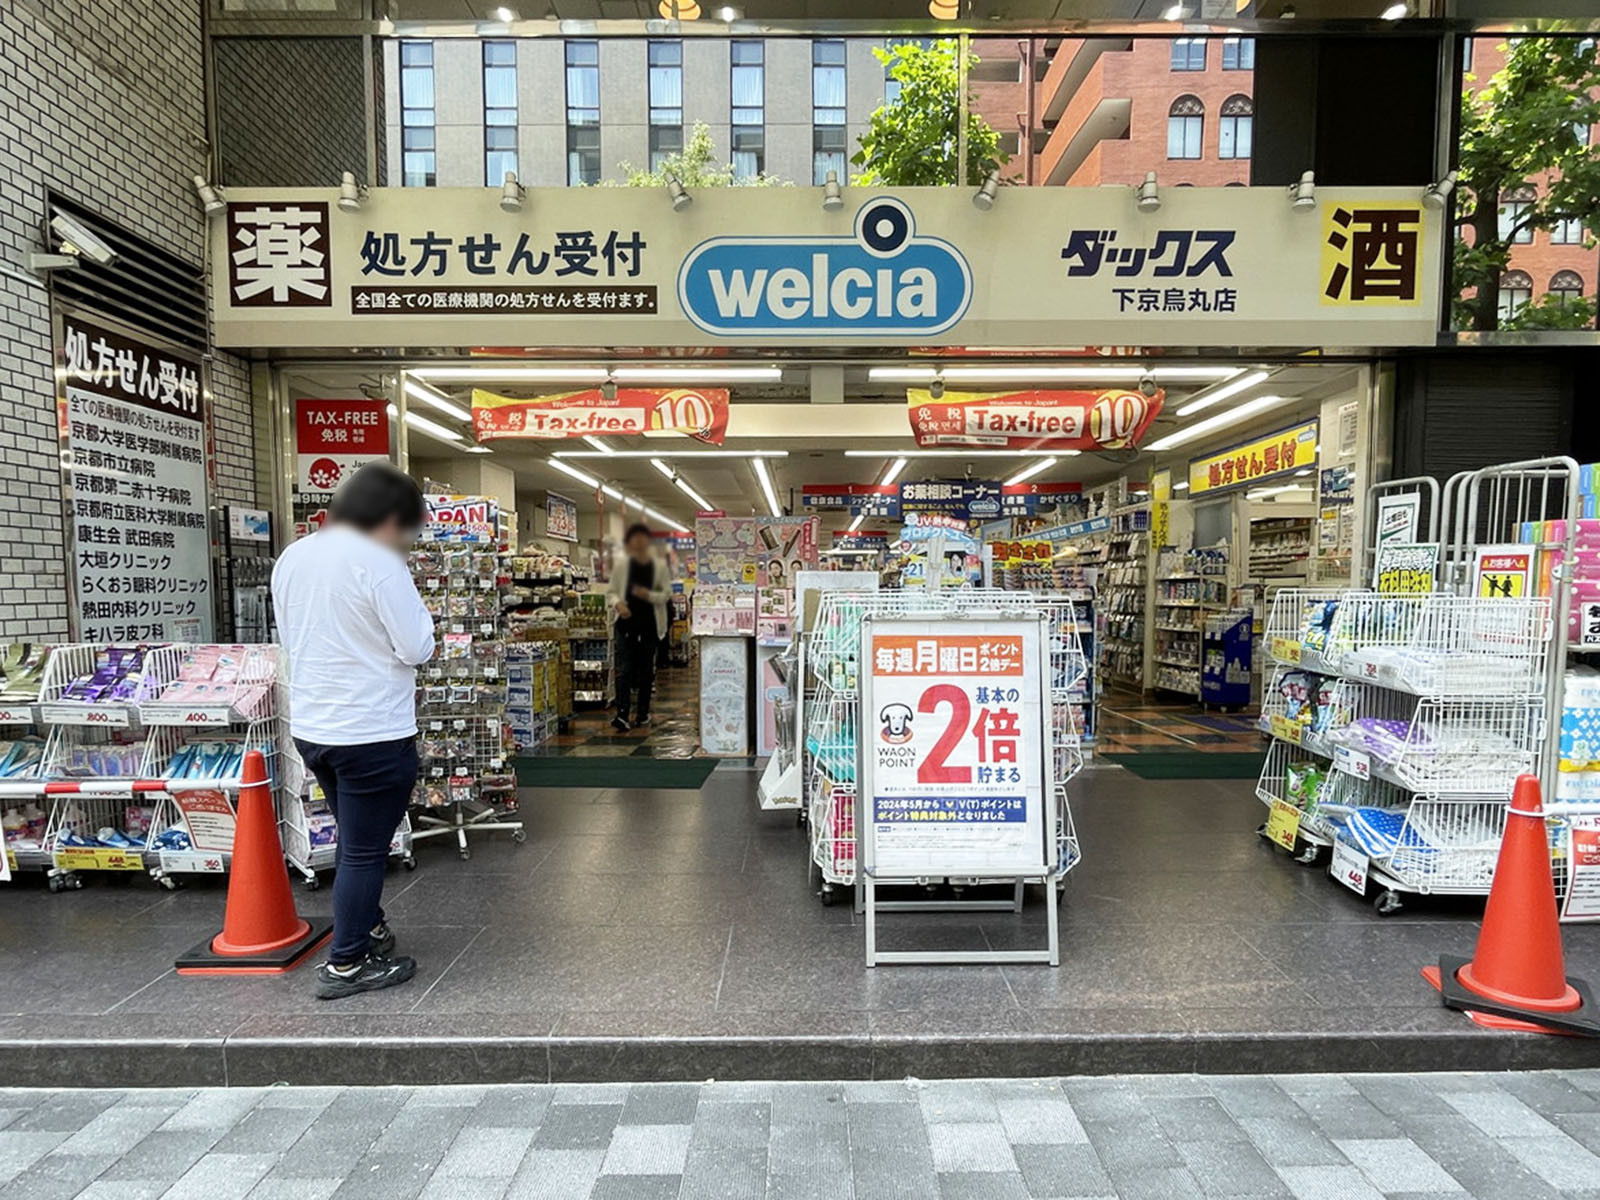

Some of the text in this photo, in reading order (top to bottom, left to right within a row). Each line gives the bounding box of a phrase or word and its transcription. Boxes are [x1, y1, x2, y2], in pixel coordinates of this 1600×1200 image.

[231, 206, 328, 302] 薬
[360, 230, 647, 277] 処方せん受付
[707, 204, 938, 320] welcia
[1061, 229, 1237, 277] ダックス
[1324, 207, 1421, 301] 酒
[354, 291, 656, 310] 全国全ての医療機関の処方せんを受付ます。
[1112, 288, 1237, 313] 下京烏丸店
[65, 325, 199, 414] 処方せん受付
[307, 411, 379, 425] TAX-FREE
[534, 411, 637, 432] Tax-free
[973, 410, 1077, 434] Tax-free
[71, 420, 203, 465] 京都大学医学部附属病院
[321, 428, 348, 442] 免税
[73, 446, 156, 478] 京都市立病院
[1207, 438, 1298, 488] 処方せん受付
[74, 473, 192, 506] 京都第二赤十字病院
[902, 483, 999, 500] お薬相談コーナー
[1031, 485, 1038, 493] 2
[75, 499, 206, 529] 京都府立医科大学附属病院
[78, 525, 176, 549] 康生会 武田病院
[79, 550, 172, 570] 大垣クリニック
[82, 576, 208, 594] らくおう眼科クリニック
[82, 600, 196, 620] 熱田内科クリニック
[84, 623, 164, 643] キハラ皮フ科
[875, 640, 978, 673] 毎週月曜日
[979, 642, 1019, 657] ポイント
[979, 657, 1020, 672] 2倍デー
[976, 686, 1020, 704] 基本の
[186, 713, 208, 722] 400
[917, 683, 972, 784] 2
[972, 707, 1021, 763] 倍
[877, 746, 916, 757] WAON
[878, 758, 916, 768] POINT
[977, 766, 1021, 784] 貯まる
